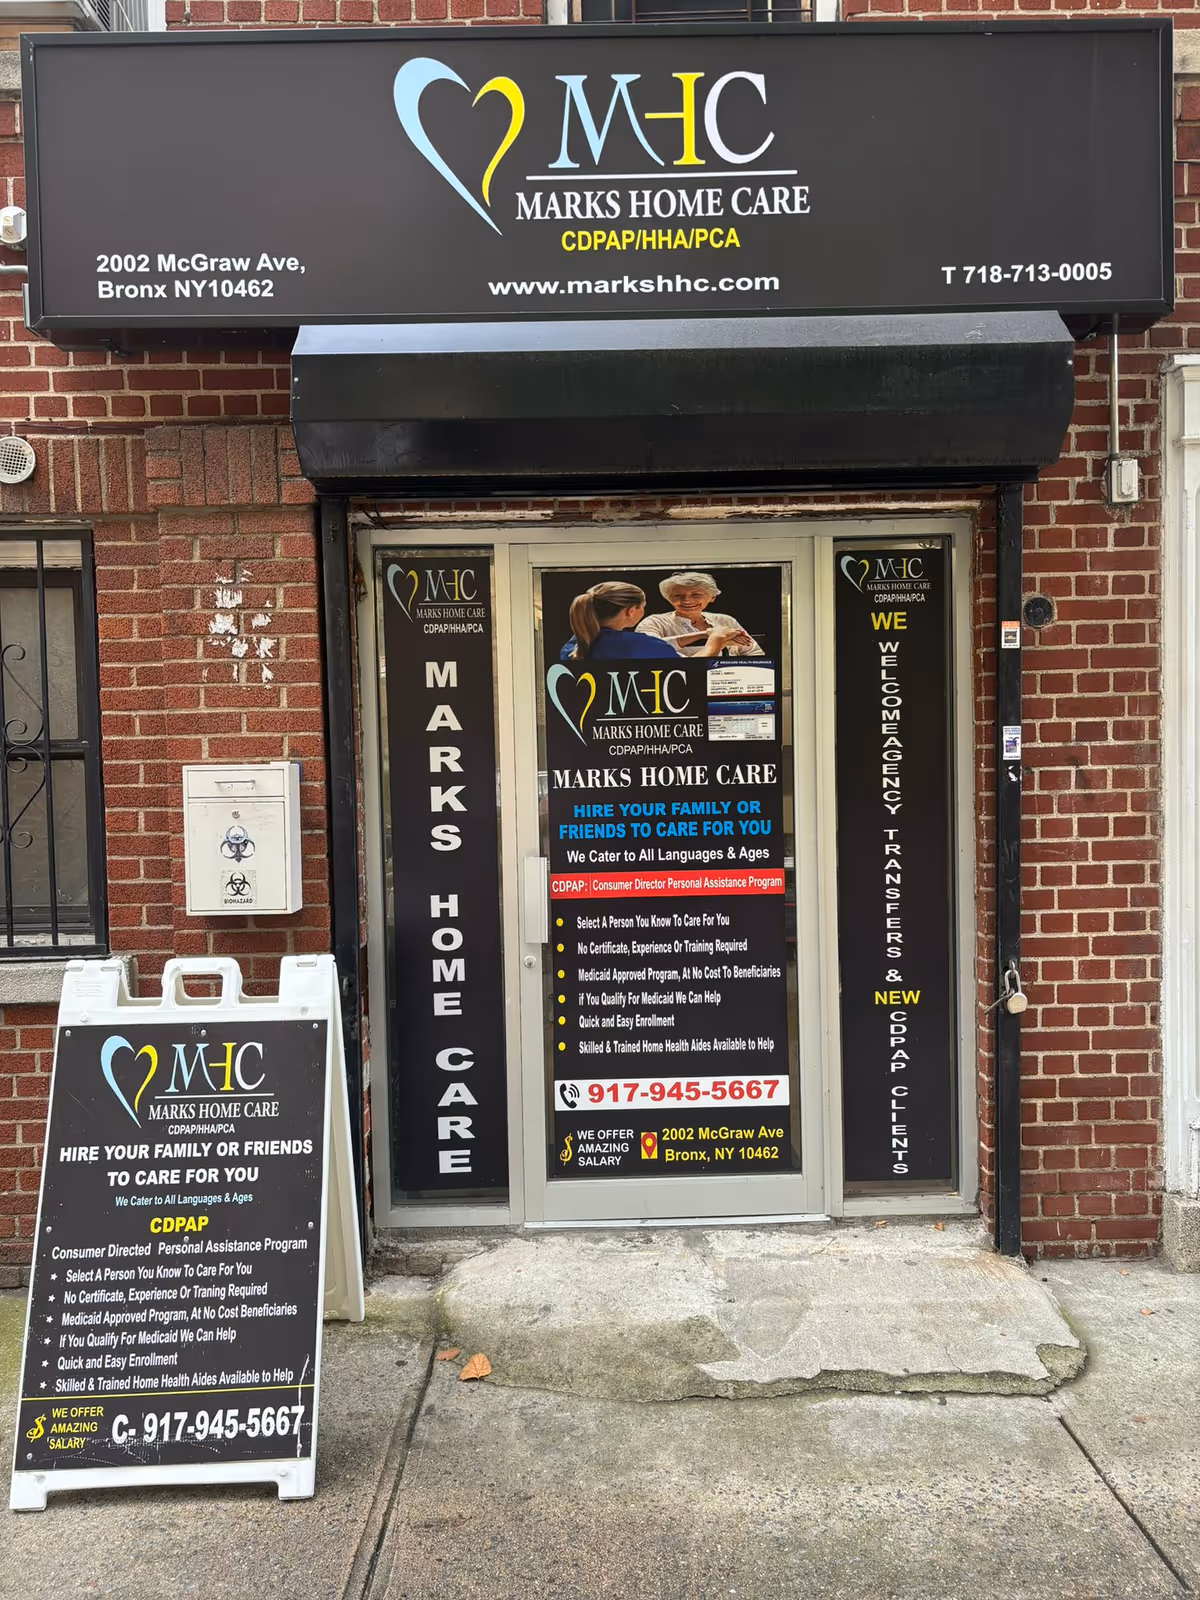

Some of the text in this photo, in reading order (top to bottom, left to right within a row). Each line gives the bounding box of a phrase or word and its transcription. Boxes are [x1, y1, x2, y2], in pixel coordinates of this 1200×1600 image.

[548, 71, 775, 169] MHC
[516, 185, 811, 221] MARKS HOME CARE
[561, 227, 741, 253] CDPAP/HHA/PCA
[96, 253, 306, 274] 2002 McGraw Ave,
[941, 263, 1113, 285] T 718-713-0005
[98, 280, 167, 299] Bronx
[487, 272, 780, 296] www.markshhc.com
[874, 558, 924, 579] MHC
[424, 569, 477, 601] MHC
[874, 593, 925, 603] CDPAP/HHA/PCA
[416, 607, 486, 618] MARKS HOME CARE
[871, 611, 907, 630] WE
[424, 623, 484, 633] CDPAP/HHA/PCA
[605, 670, 690, 716] MHC
[592, 726, 632, 740] MARKS
[635, 725, 672, 738] HOME
[674, 724, 704, 738] CARE
[609, 744, 693, 756] CDPAP/HHA/PCA
[552, 764, 777, 789] MARKS HOME CARE
[574, 801, 761, 817] HIRE YOUR FAMILY OR
[559, 819, 771, 839] FRIENDS TO CARE FOR YOU
[567, 847, 769, 862] We Cater to All Languages & Ages
[552, 876, 782, 892] CDPAP: Consumer Director Personal Assistance Program
[883, 829, 904, 958] TRANSFERS
[425, 661, 478, 1173] MARKS HOME CARE
[577, 914, 730, 929] Select A Person You Know To Care For You
[577, 939, 747, 956] No Certificate, Experience Or Training Required
[885, 969, 902, 982] &
[578, 991, 721, 1007] if You Qualify For Medicaid We Can Help
[874, 990, 920, 1004] NEW
[579, 1015, 674, 1030] Quick and Easy Enrollment
[165, 1041, 266, 1092] MHC
[588, 1079, 779, 1103] 917-945-5667
[890, 1011, 910, 1173] CDPAP CLIENTS
[148, 1101, 279, 1120] MARKS HOME CARE
[168, 1124, 235, 1135] CDPAP/HHA/PCA
[577, 1129, 634, 1139] WE OFFER
[662, 1126, 784, 1141] 2002 McGraw Ave
[59, 1140, 313, 1162] HIRE YOUR FAMILY OR FRIENDS
[577, 1143, 629, 1153] AMAZING
[665, 1147, 779, 1163] Bronx, NY 10462
[578, 1156, 621, 1167] SALARY
[107, 1167, 259, 1186] TO CARE FOR YOU
[150, 1216, 208, 1234] CDPAP
[52, 1238, 308, 1260] Consumer Directed Personal Assistance Program
[64, 1282, 268, 1304] No Certificate, Experience Or Traning Required
[57, 1353, 177, 1371] Quick and Easy Enrollment
[56, 1368, 293, 1393] Skilled & Trained Home Health Aides Available to Help
[52, 1407, 104, 1418] WE OFFER
[50, 1423, 98, 1433] AMAZING
[112, 1406, 304, 1443] C- 917-945-5667
[49, 1438, 86, 1449] SALARY
